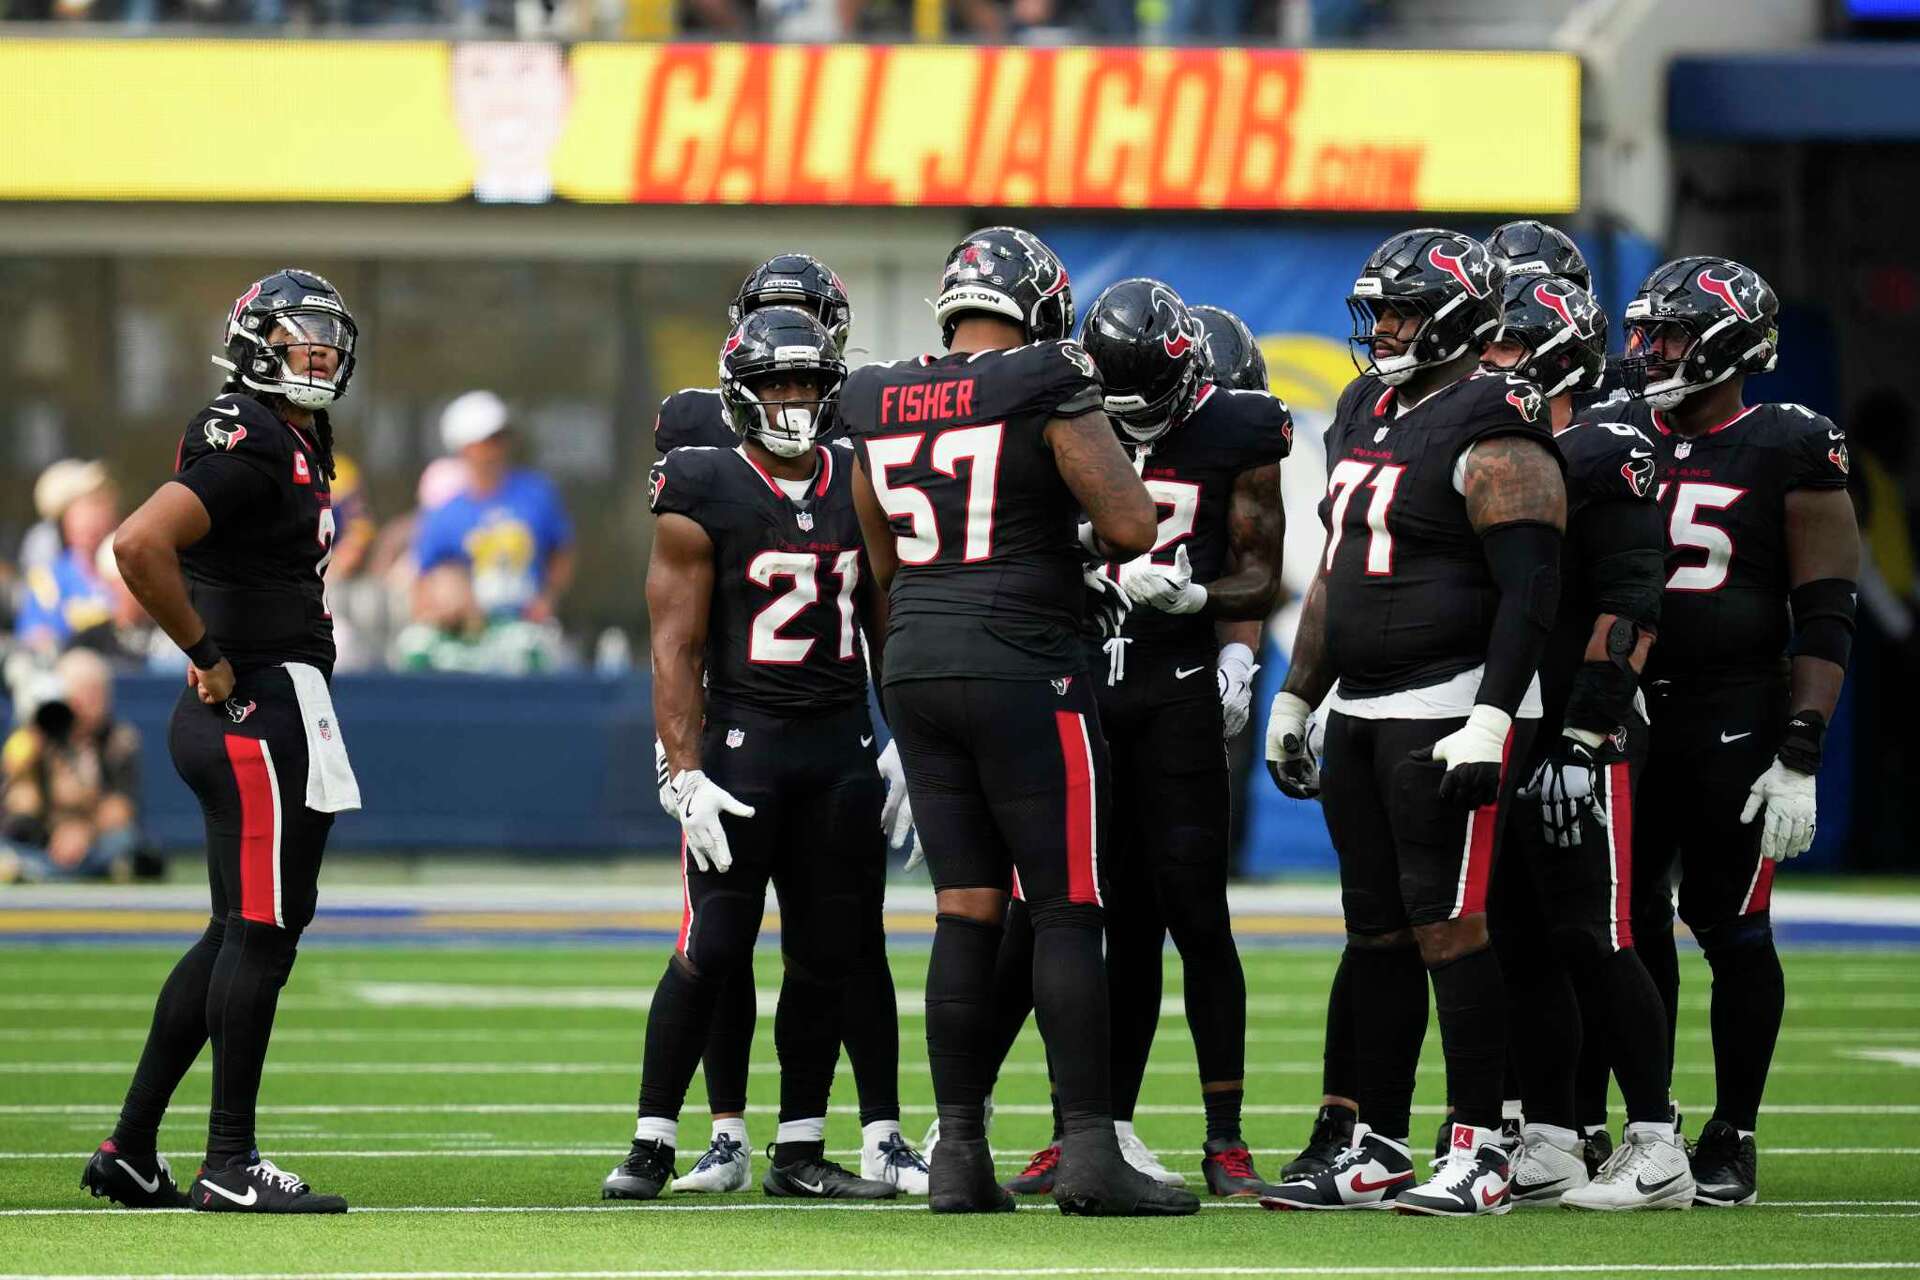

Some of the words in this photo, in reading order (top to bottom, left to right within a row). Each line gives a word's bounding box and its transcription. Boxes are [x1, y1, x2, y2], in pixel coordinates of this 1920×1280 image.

[937, 291, 1001, 310] HOUSTON
[880, 378, 975, 426] FISHER
[864, 420, 1006, 566] 57
[1325, 457, 1408, 577] 71
[1655, 480, 1750, 592] 5
[746, 549, 862, 665] 21
